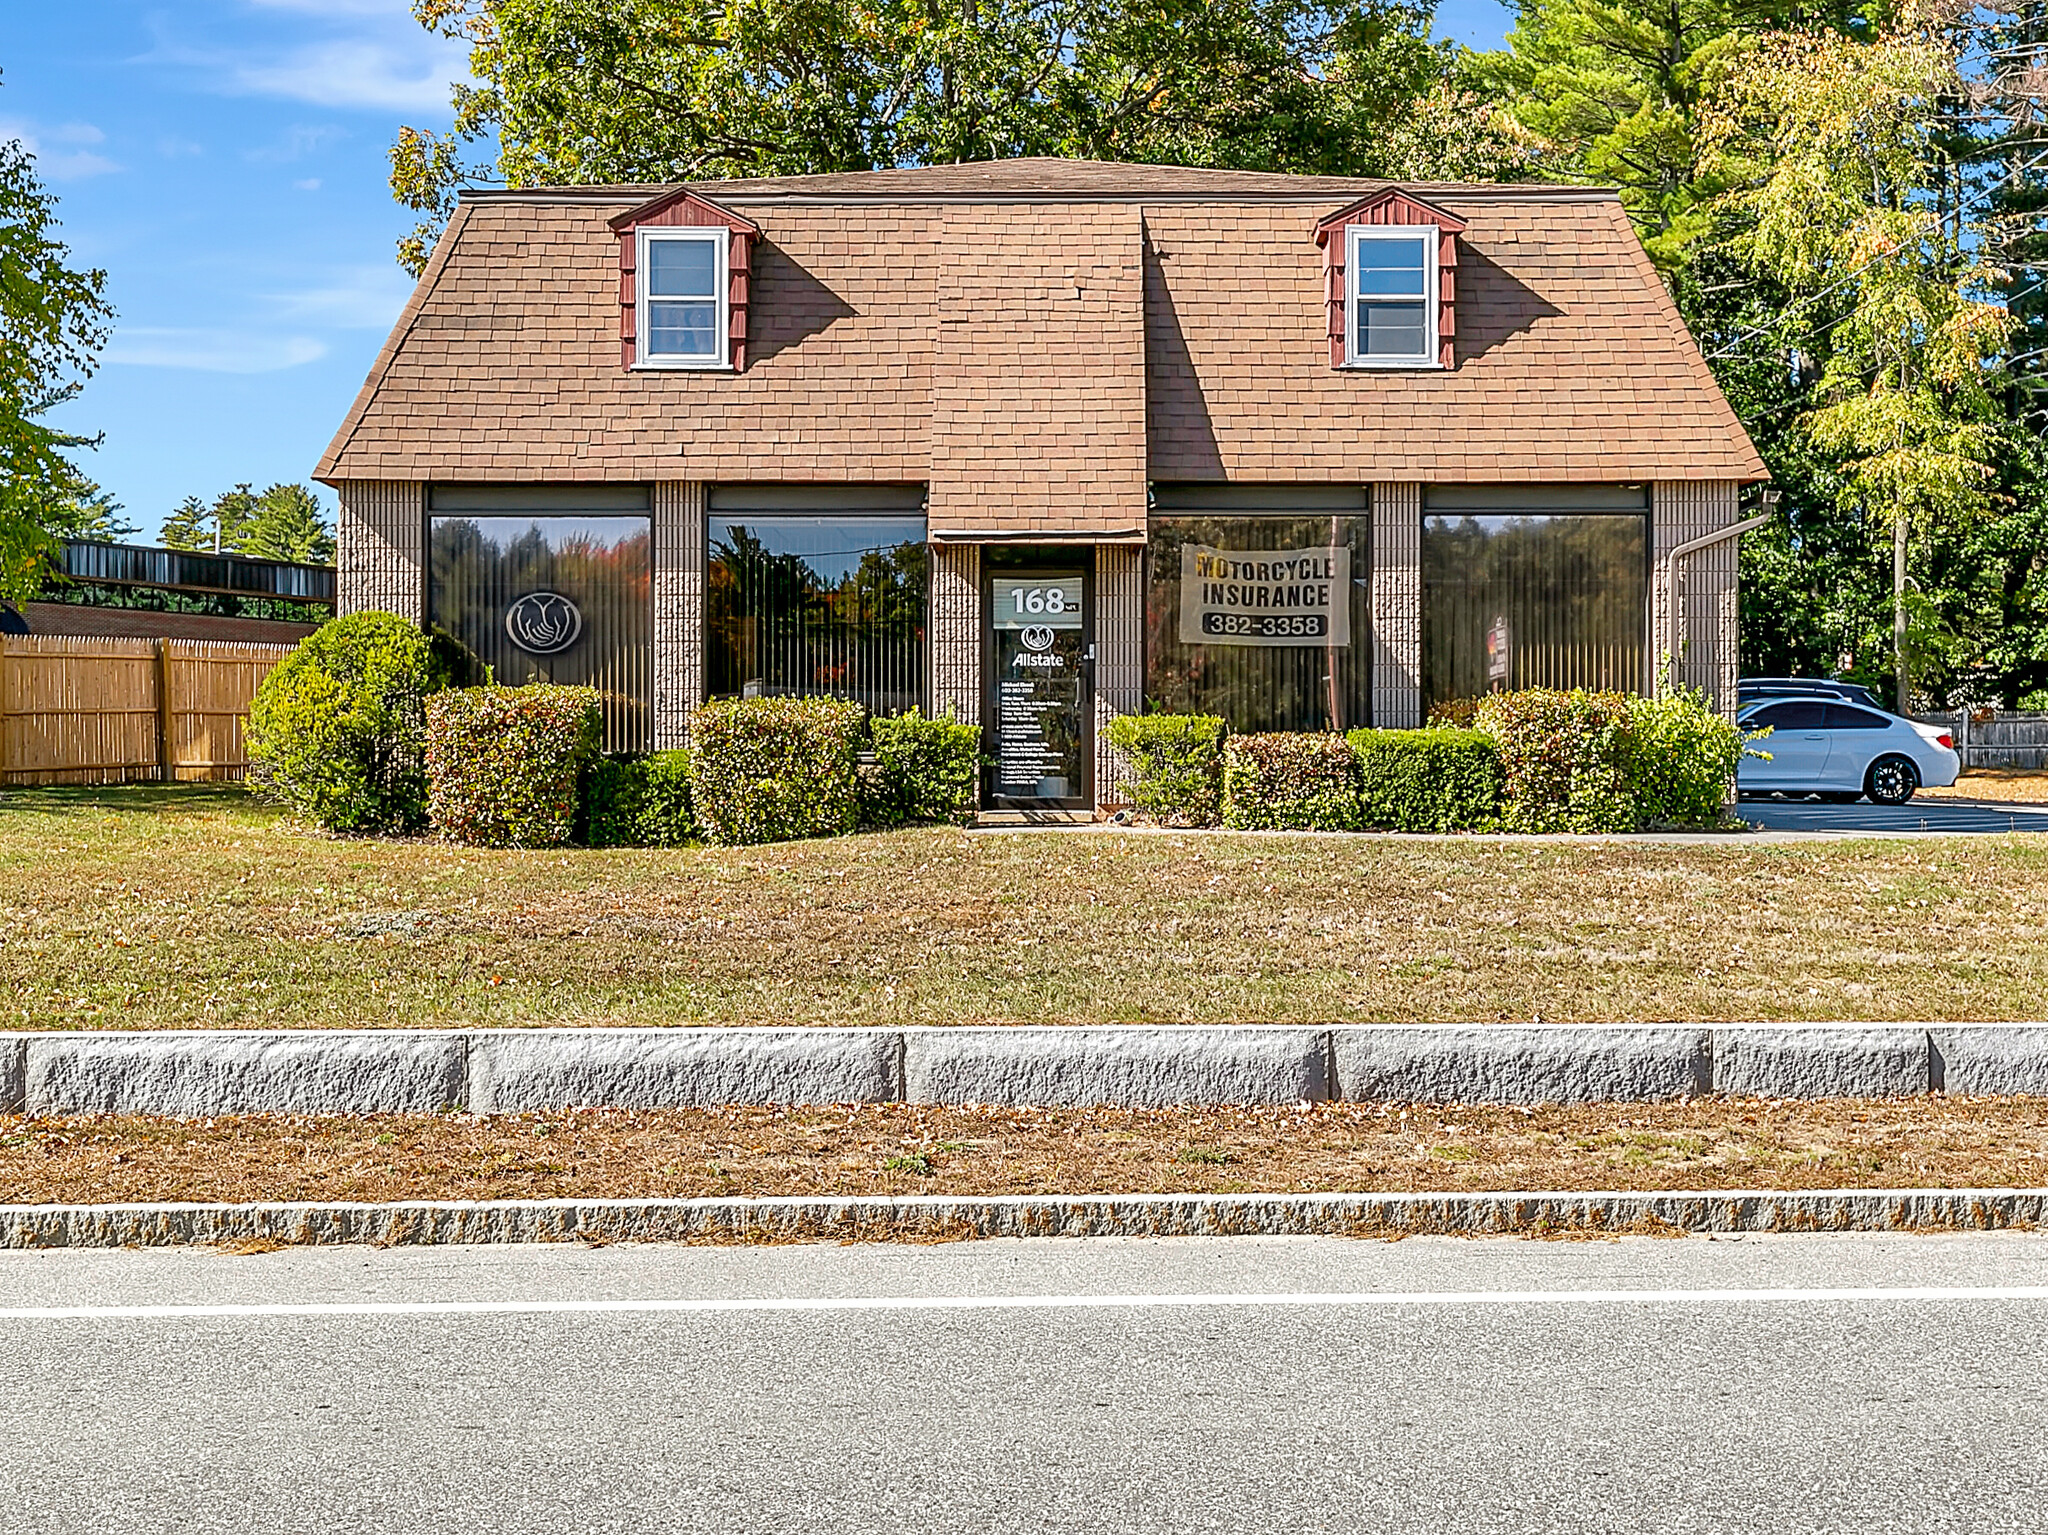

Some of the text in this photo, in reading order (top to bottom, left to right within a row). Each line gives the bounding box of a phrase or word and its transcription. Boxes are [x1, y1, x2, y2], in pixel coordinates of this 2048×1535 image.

[1196, 552, 1335, 581] MOTORCYCLE
[1011, 588, 1065, 614] 168
[1203, 583, 1329, 607] INSURANCE
[1210, 615, 1320, 635] 382-3358
[1012, 653, 1064, 667] Allstate
